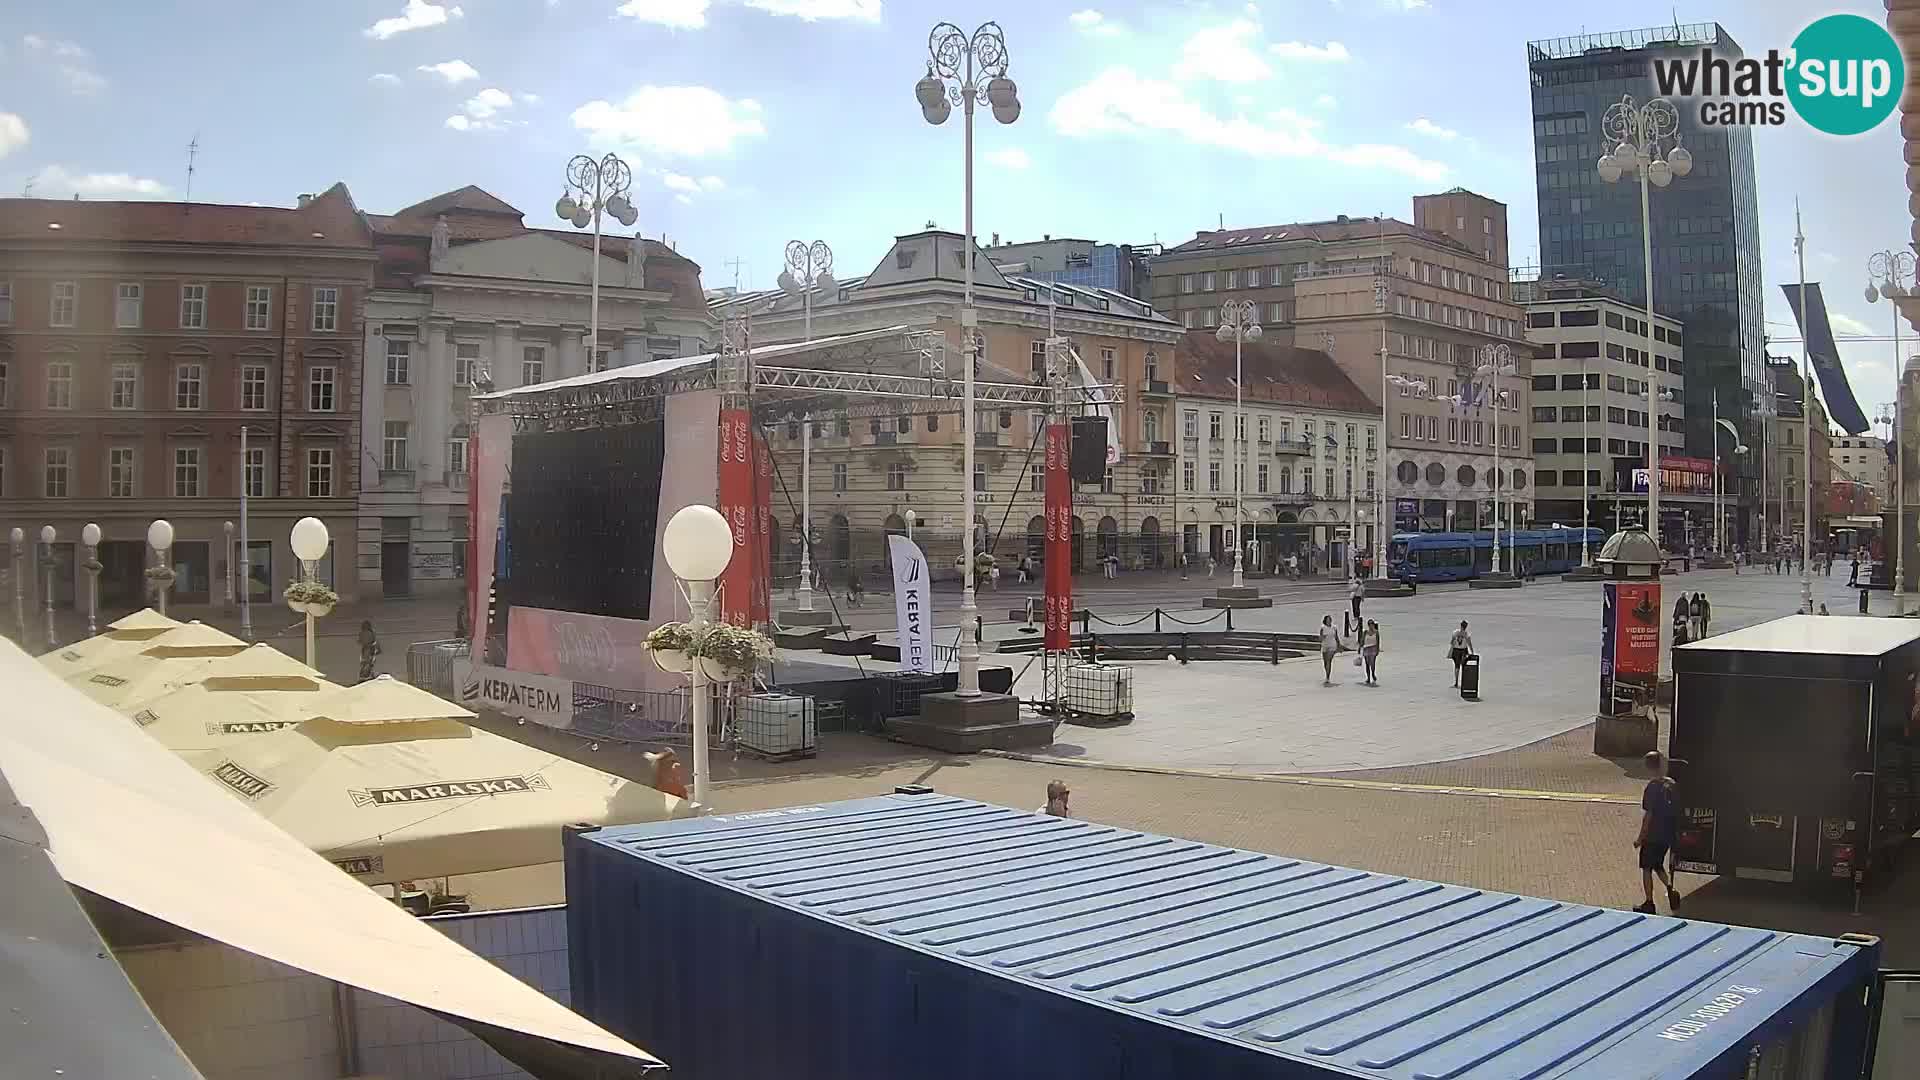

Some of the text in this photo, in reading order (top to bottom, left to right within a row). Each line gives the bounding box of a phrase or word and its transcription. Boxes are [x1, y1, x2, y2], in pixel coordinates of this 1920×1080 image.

[1137, 496, 1165, 505] SINGER
[483, 678, 561, 714] KERATERM
[381, 778, 524, 804] MARASKA
